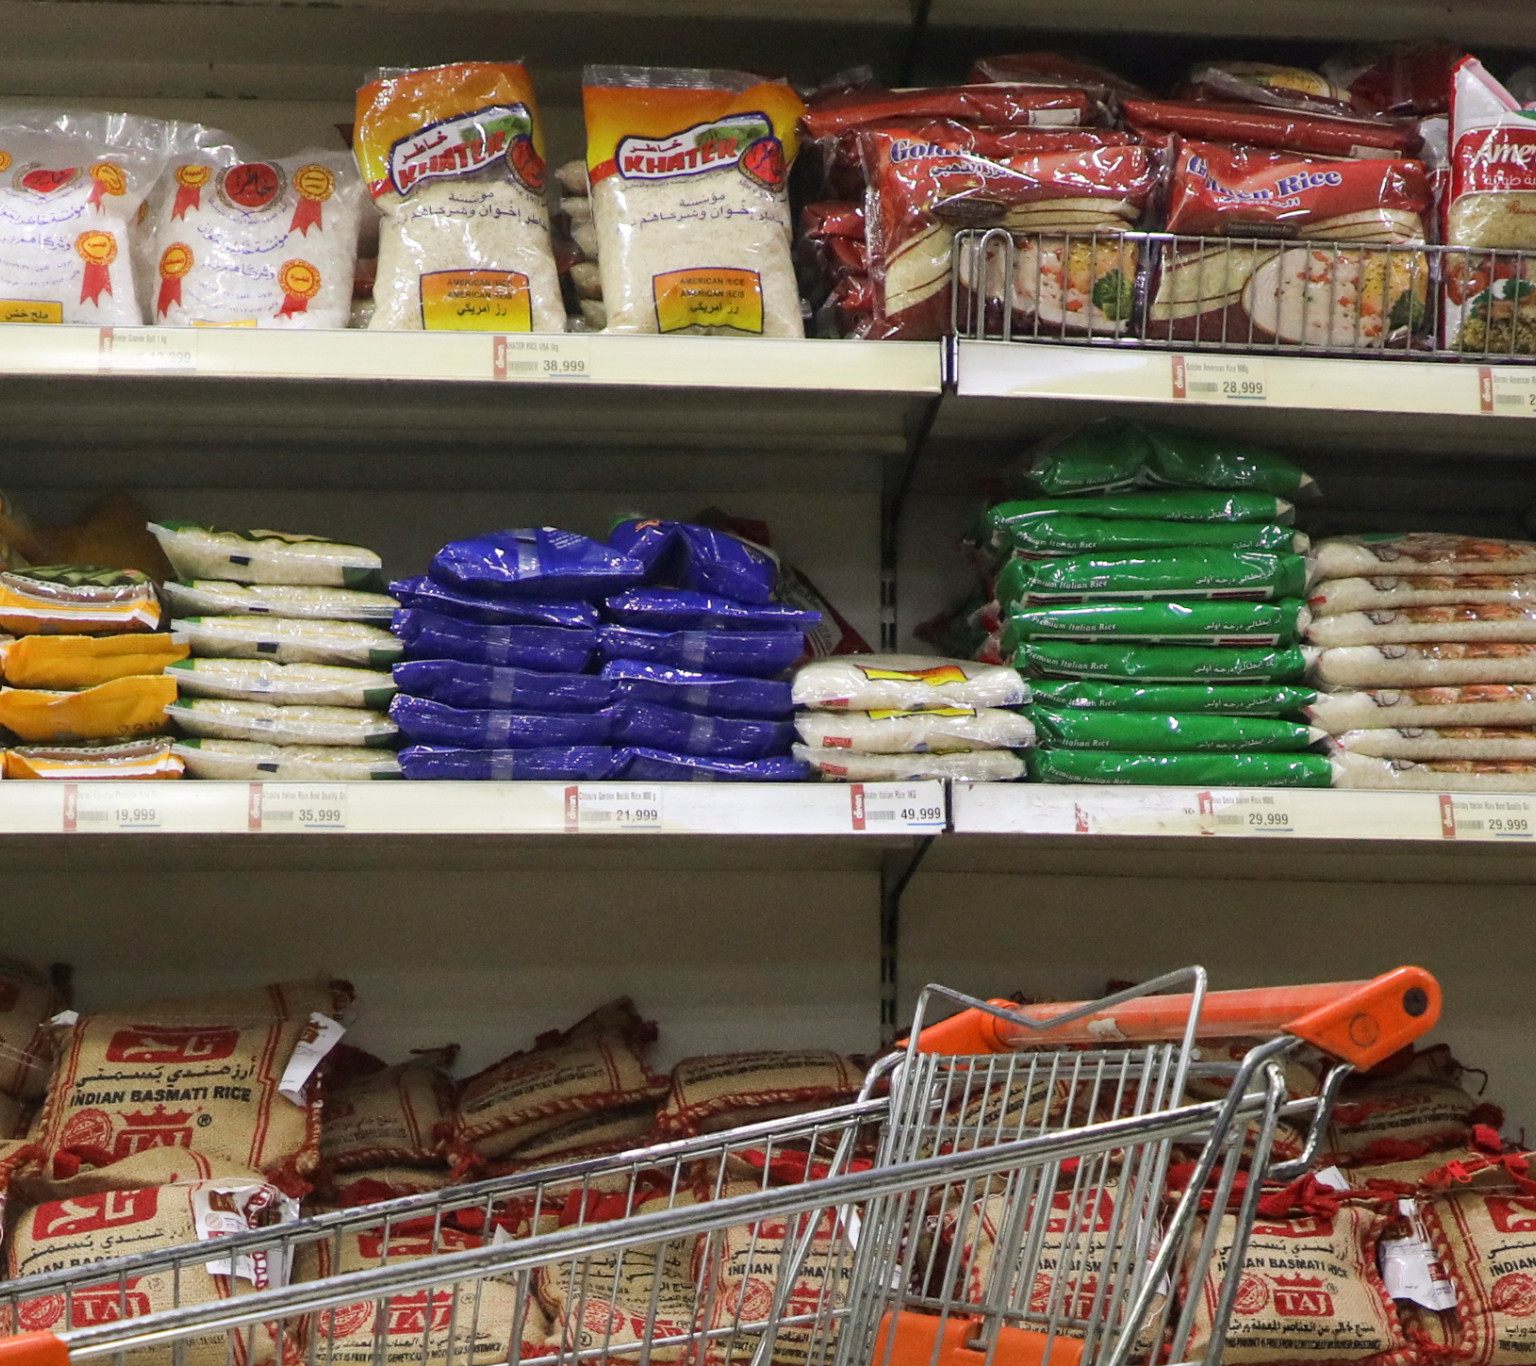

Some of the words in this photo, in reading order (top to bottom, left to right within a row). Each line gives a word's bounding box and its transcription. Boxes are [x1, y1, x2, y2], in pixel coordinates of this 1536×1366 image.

[402, 131, 448, 164] خاطر
[630, 140, 684, 154] خاطر
[398, 131, 506, 189] KHATER
[624, 137, 739, 173] KHATER
[1275, 171, 1343, 198] Rice
[680, 277, 724, 286] AMERICAN
[725, 278, 746, 287] RICE
[680, 289, 724, 298] AMERICAN
[543, 360, 585, 373] 38,999
[1223, 381, 1263, 395] 28,999
[1058, 580, 1088, 589] Italian
[1090, 579, 1108, 588] Rice
[1068, 622, 1097, 632] Italian
[1098, 622, 1117, 631] Rice
[1027, 649, 1060, 665] Premium
[1061, 660, 1088, 671] Italian
[1090, 661, 1109, 671] Rice
[1092, 739, 1111, 748] Rice
[895, 789, 906, 799] Rice
[853, 794, 863, 819] diwan
[115, 808, 156, 821] 19,999
[299, 809, 341, 822] 35,999
[616, 809, 658, 822] 21,999
[900, 807, 941, 821] 49,999
[1249, 813, 1289, 826] 29,999
[1489, 819, 1528, 831] 29,999
[123, 1036, 214, 1060] تاج
[70, 1090, 126, 1107] INDIAN
[130, 1086, 208, 1104] BASMATI
[212, 1085, 252, 1103] RICE
[46, 1188, 141, 1235] تاج
[1268, 1258, 1326, 1272] BASMATI
[1489, 1256, 1536, 1277] INDIAN
[83, 1297, 142, 1322] TAJ
[1280, 1292, 1328, 1315] TAJ
[387, 1308, 450, 1331] TAJ
